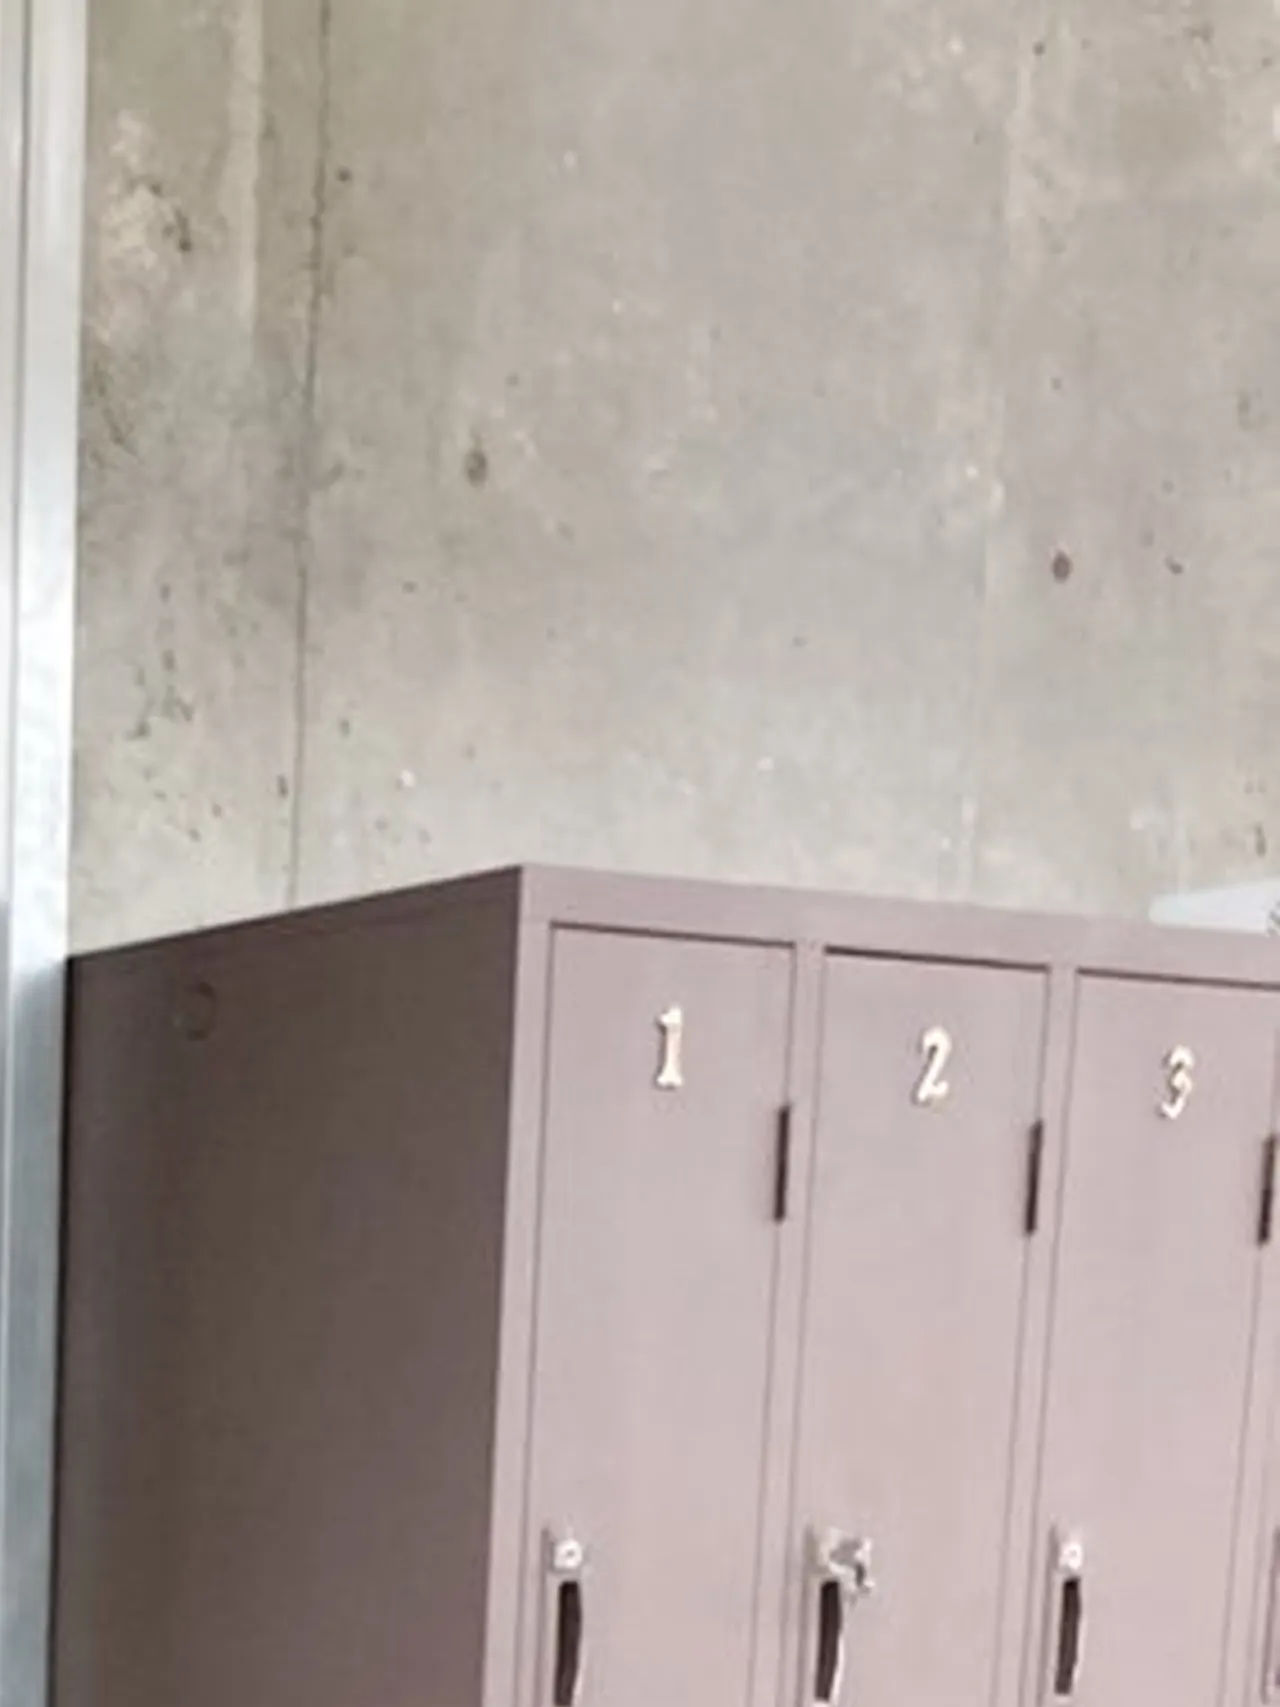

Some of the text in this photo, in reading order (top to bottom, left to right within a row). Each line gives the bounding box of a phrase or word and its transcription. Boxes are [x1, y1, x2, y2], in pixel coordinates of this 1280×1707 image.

[654, 1004, 685, 1089] 1
[914, 1026, 951, 1104] 2
[1160, 1045, 1193, 1121] 3
